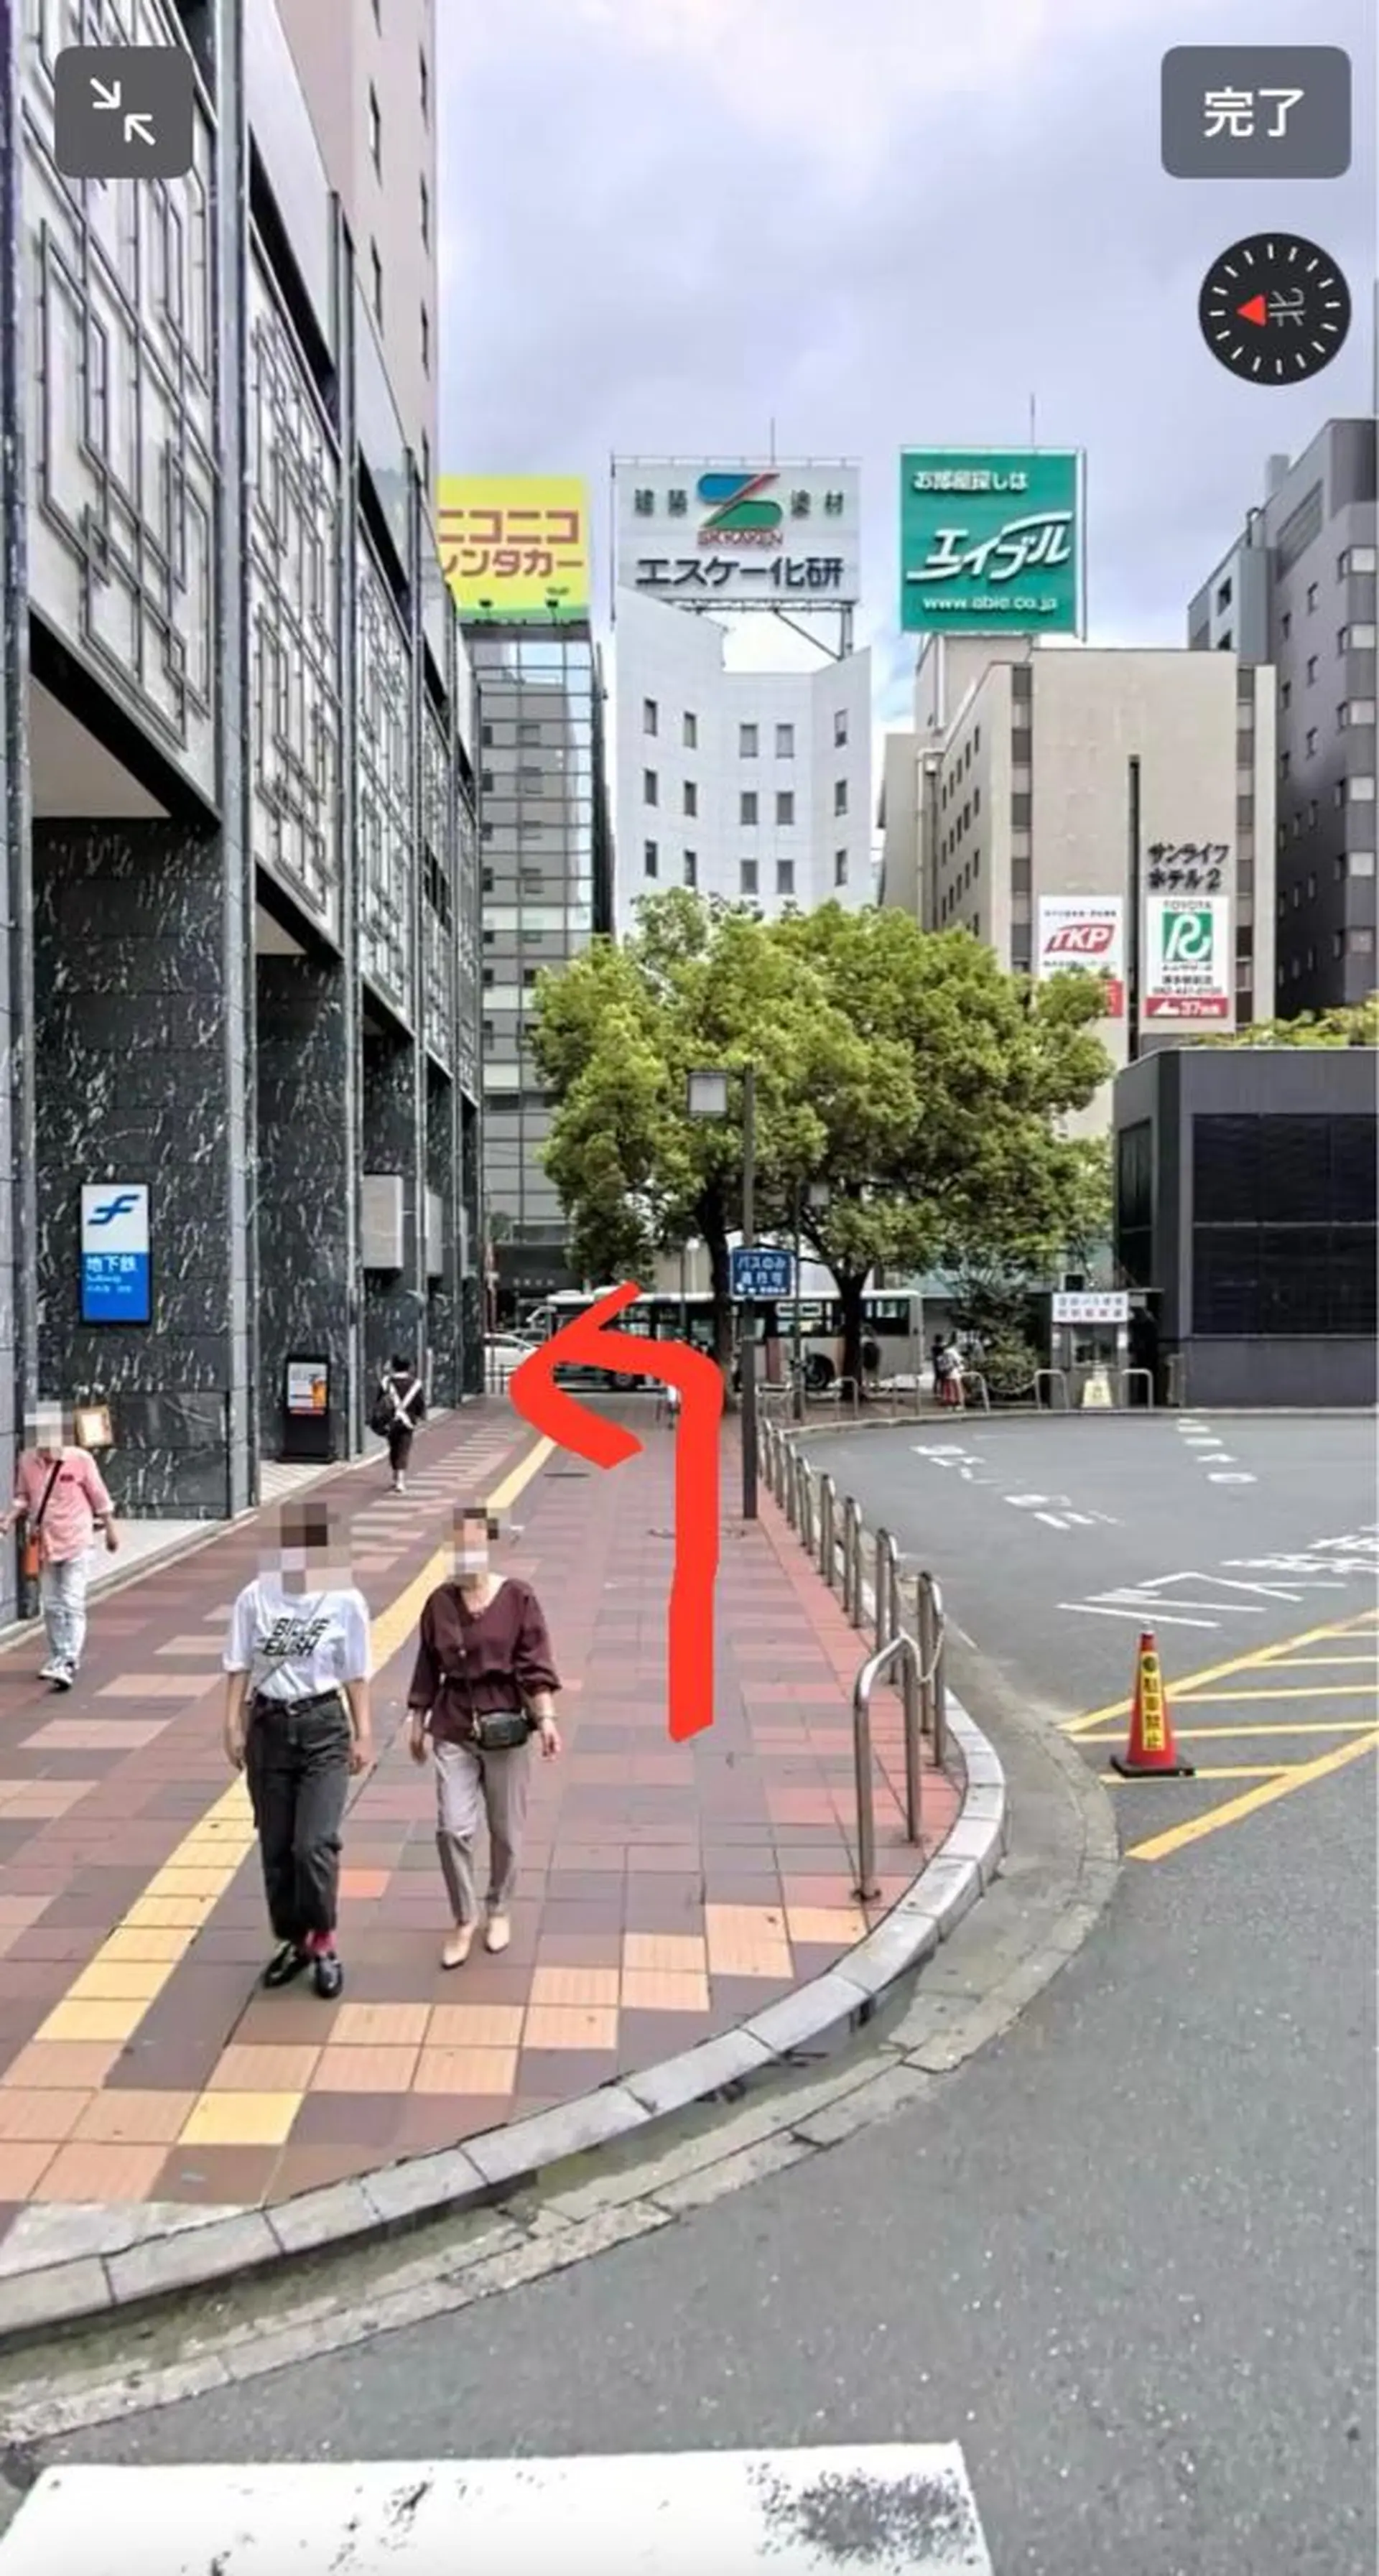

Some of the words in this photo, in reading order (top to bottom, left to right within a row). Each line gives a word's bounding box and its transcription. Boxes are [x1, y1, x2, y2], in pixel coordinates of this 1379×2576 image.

[439, 510, 580, 544] ニコニコ
[906, 511, 1072, 580] エイブル
[636, 558, 843, 587] エスケー化研
[1149, 842, 1230, 863] サンライフ
[1150, 868, 1222, 890] ホテル2
[1051, 928, 1109, 949] TKP
[86, 1256, 136, 1273] 地下鉄
